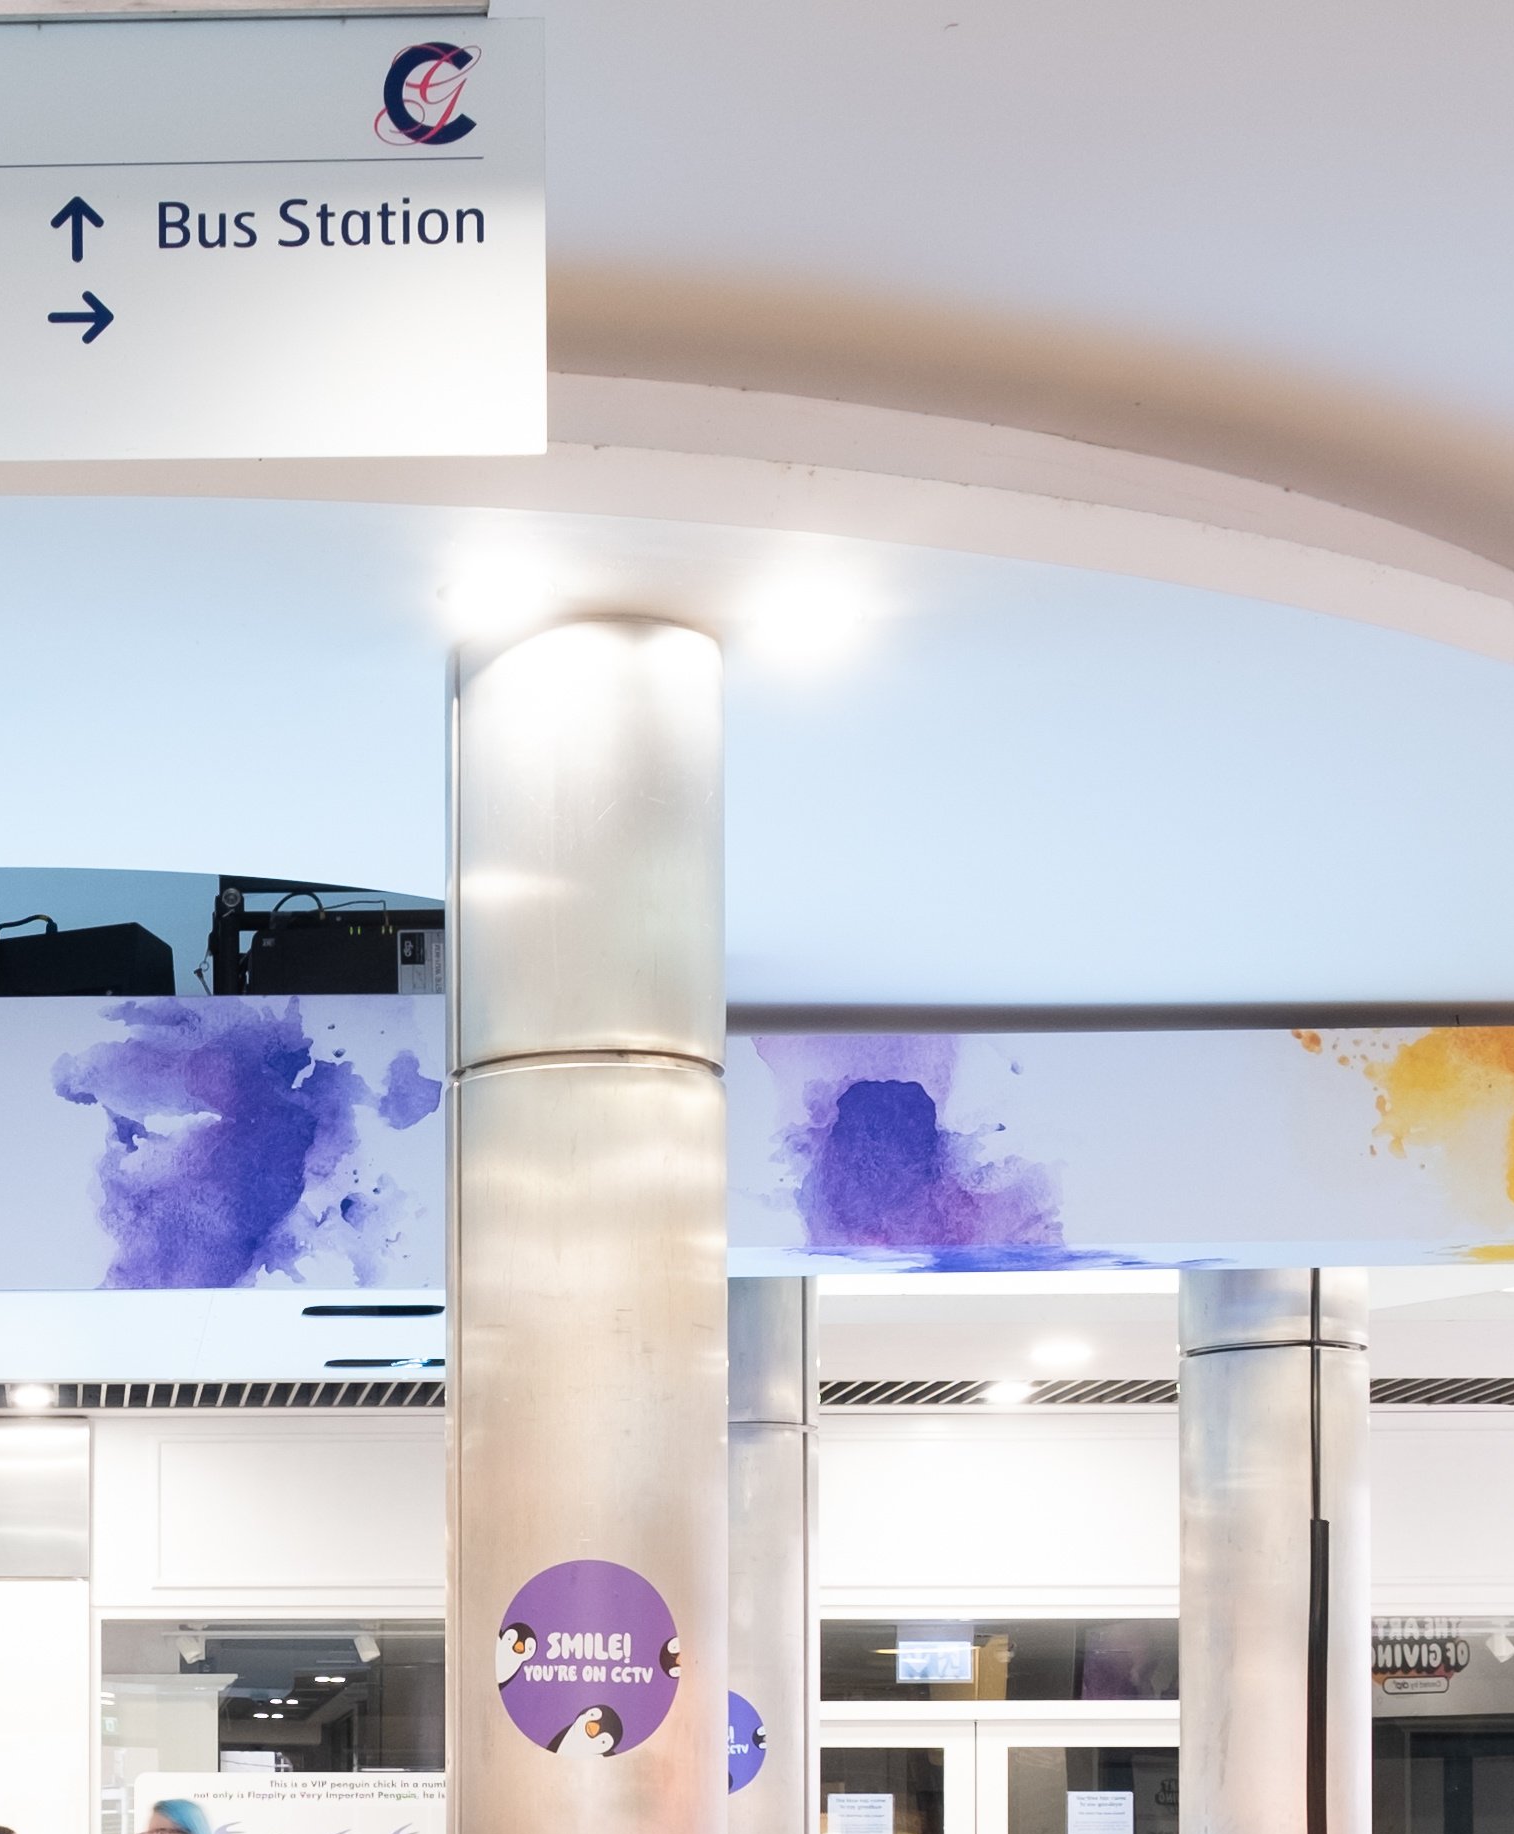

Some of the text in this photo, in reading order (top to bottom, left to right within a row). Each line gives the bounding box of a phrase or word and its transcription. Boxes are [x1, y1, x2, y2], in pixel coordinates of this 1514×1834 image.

[159, 198, 484, 248] Bus Station
[547, 1632, 631, 1663] SMILE!
[524, 1665, 653, 1683] YOU'RE ON CCTV
[311, 1780, 327, 1788] VIP
[330, 1780, 370, 1791] penguin
[373, 1780, 397, 1788] chick
[326, 1791, 374, 1801] Important
